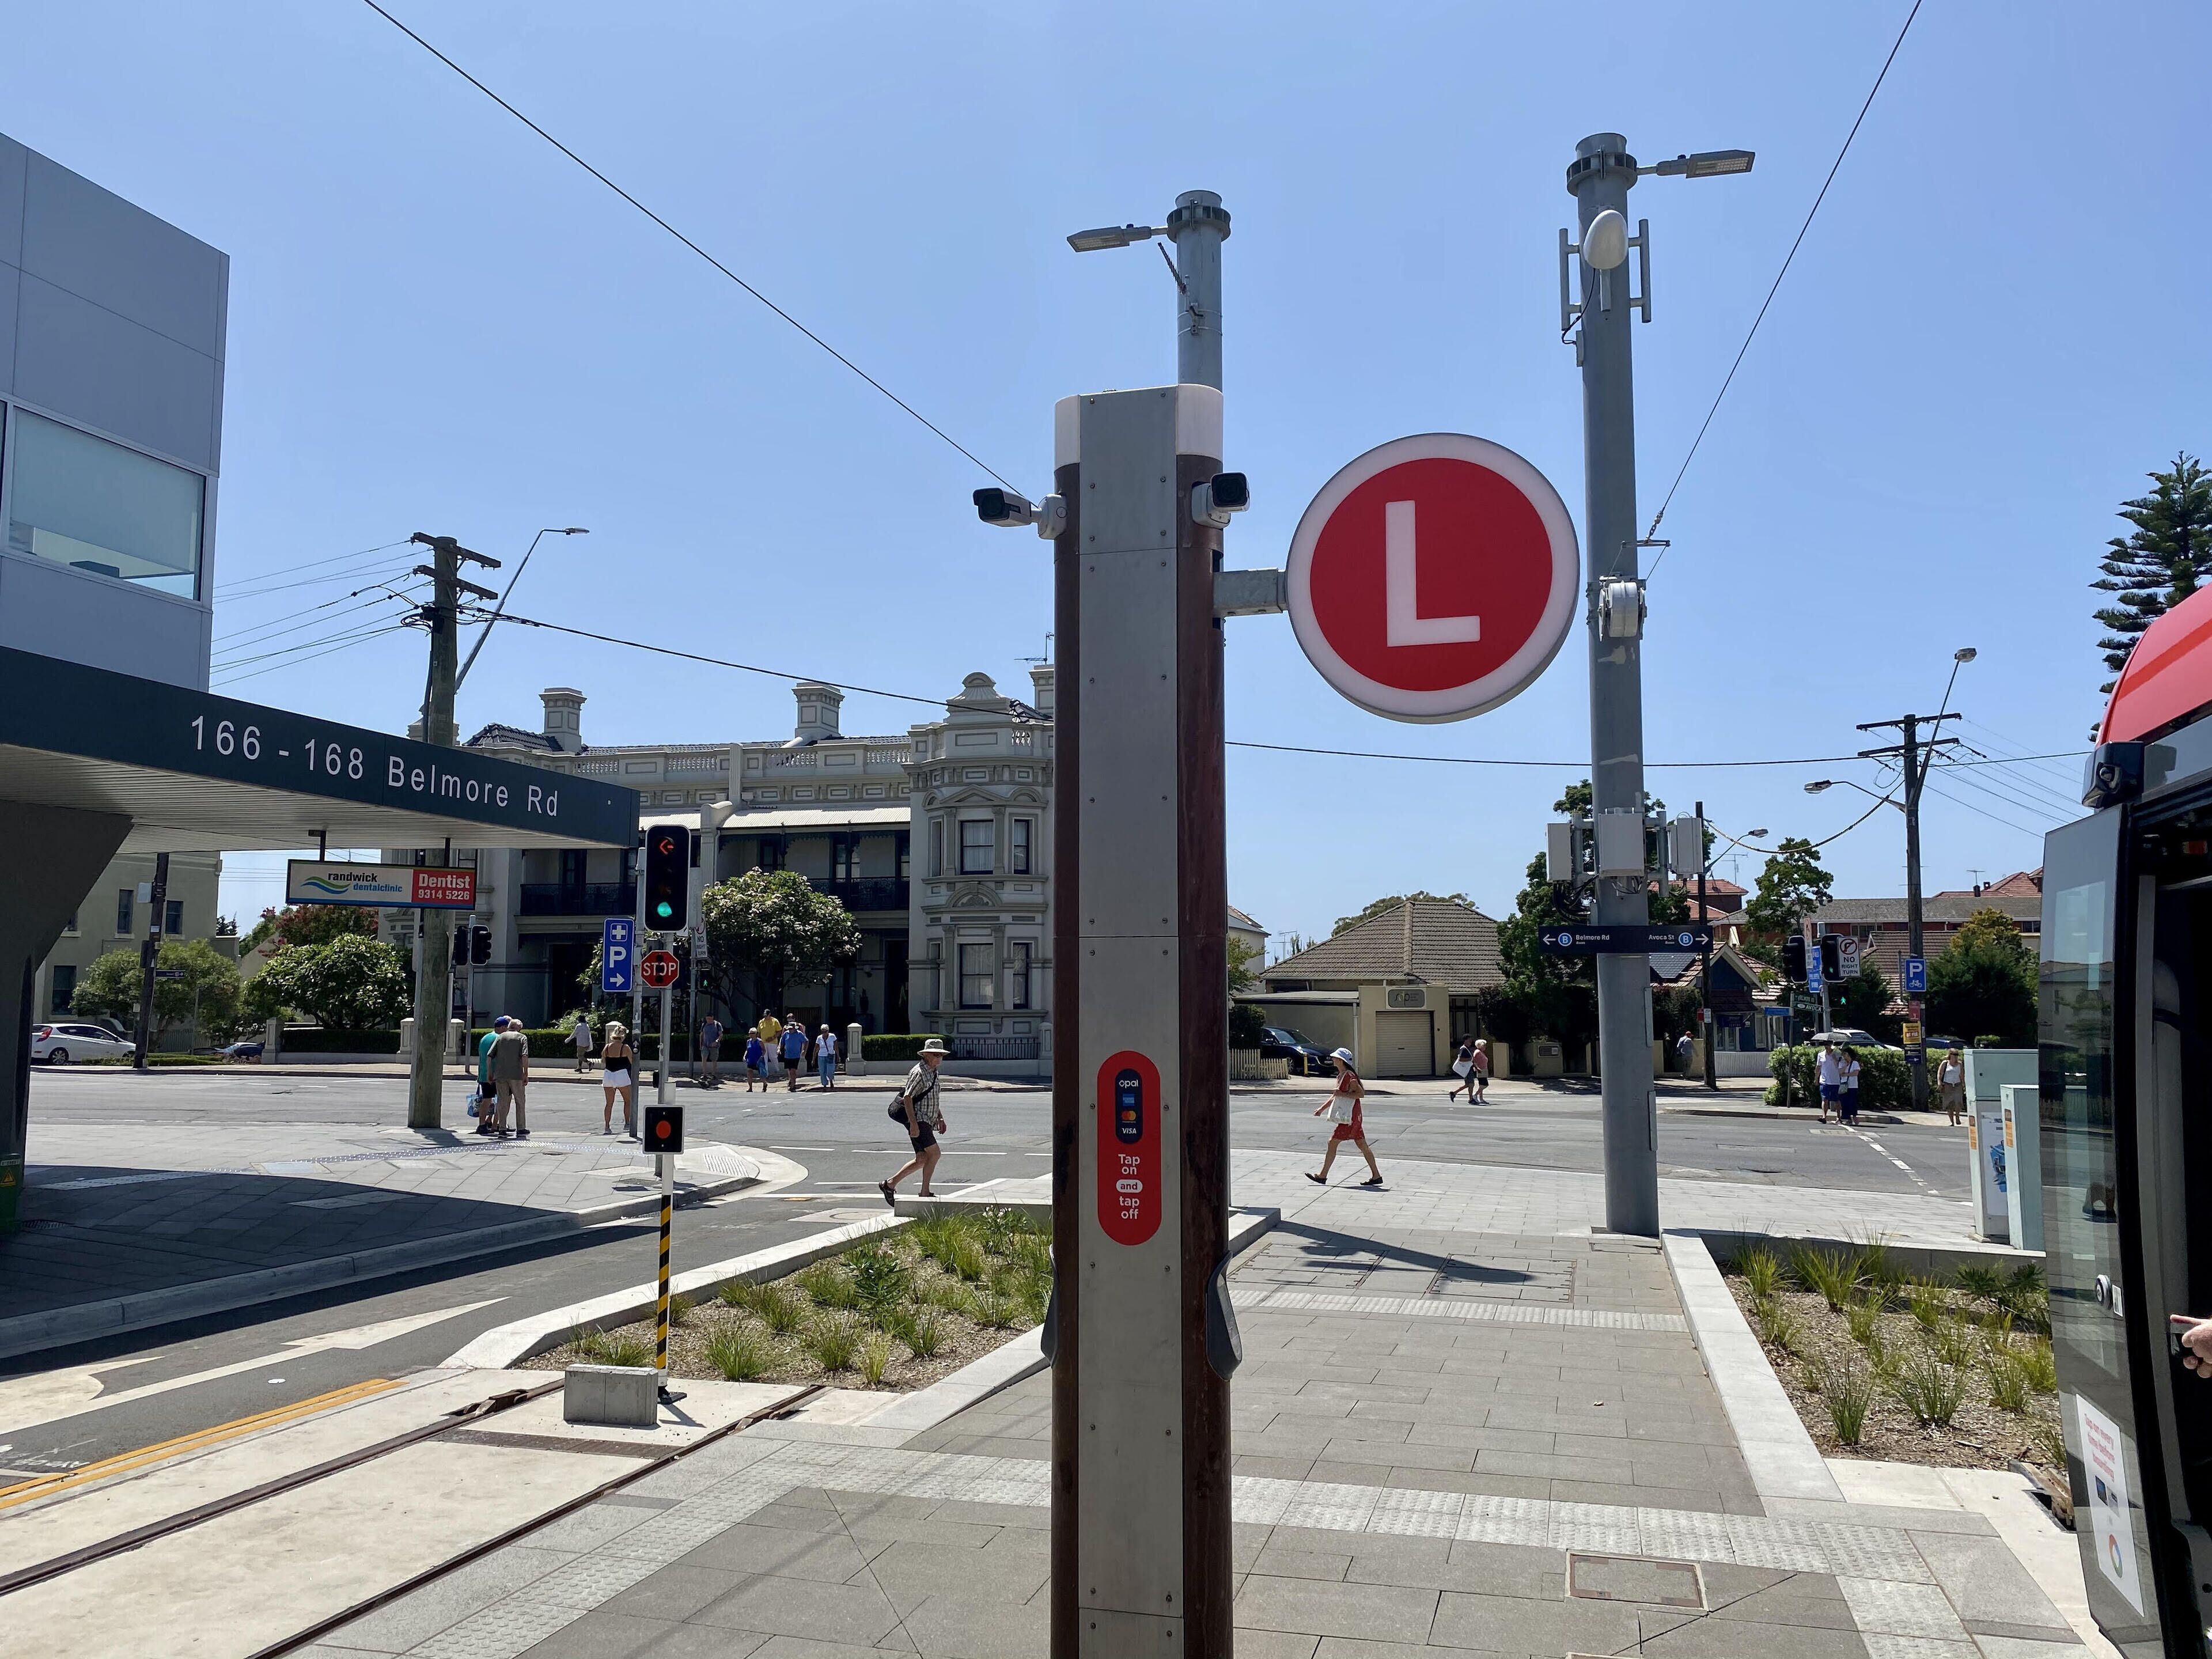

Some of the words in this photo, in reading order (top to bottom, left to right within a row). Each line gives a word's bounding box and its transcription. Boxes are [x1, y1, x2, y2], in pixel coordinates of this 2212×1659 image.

[1385, 500, 1480, 647] L
[191, 715, 262, 760] 166
[305, 738, 364, 779] 168
[388, 756, 509, 807] Belmore
[528, 785, 558, 816] Rd
[328, 872, 378, 882] randwick
[419, 874, 470, 888] Dentist
[353, 883, 403, 892] dentalclinic
[418, 889, 442, 900] 9314
[445, 891, 470, 900] 5226
[609, 946, 627, 968] P
[1910, 963, 1923, 978] P
[1806, 1004, 1821, 1012] AVOCA
[1119, 1080, 1139, 1088] opal
[1118, 1154, 1141, 1166] Tap
[1122, 1166, 1137, 1175] on
[1120, 1181, 1138, 1191] and
[1119, 1196, 1140, 1208] tap
[1121, 1209, 1139, 1219] off
